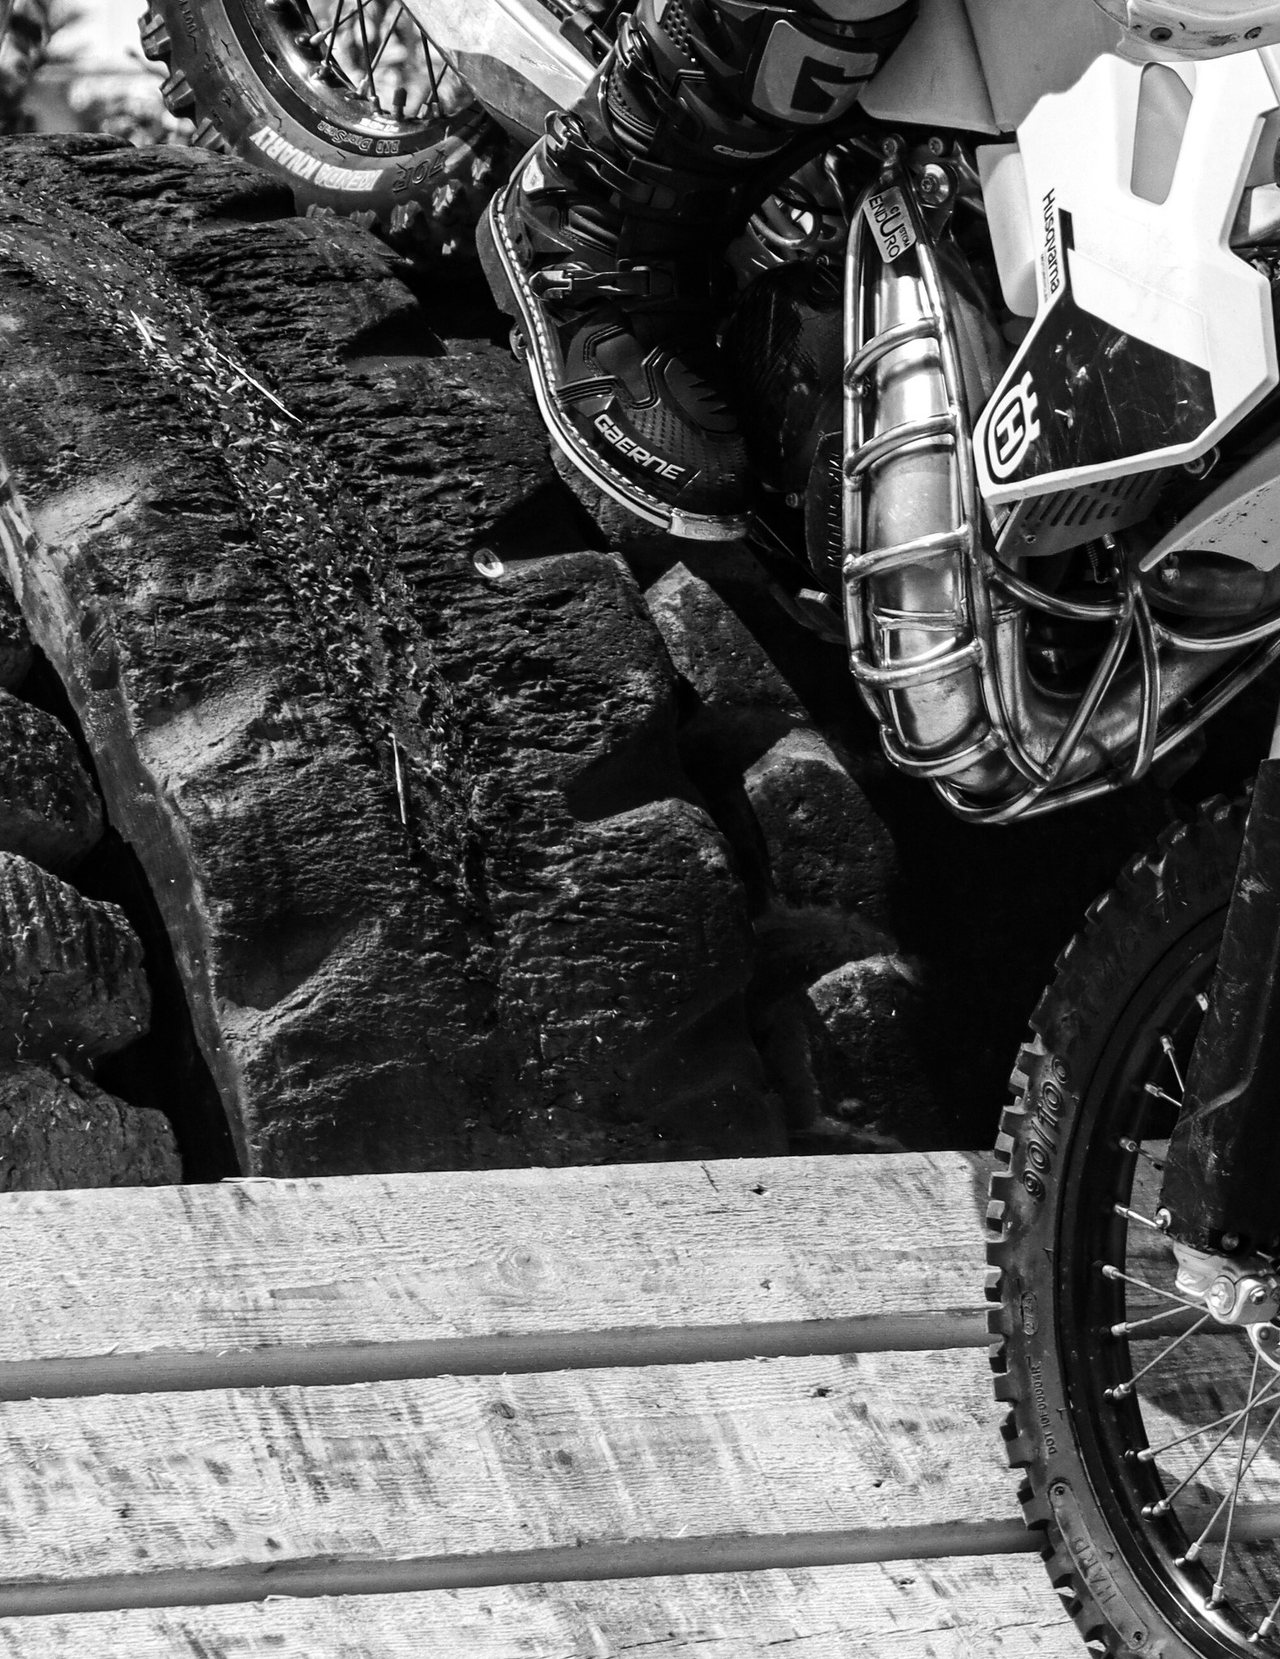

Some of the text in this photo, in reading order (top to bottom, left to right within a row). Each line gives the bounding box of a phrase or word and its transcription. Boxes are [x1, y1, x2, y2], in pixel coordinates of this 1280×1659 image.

[249, 126, 322, 179] KNARLY
[315, 166, 384, 191] KENDA
[1042, 187, 1061, 294] Husqvarna
